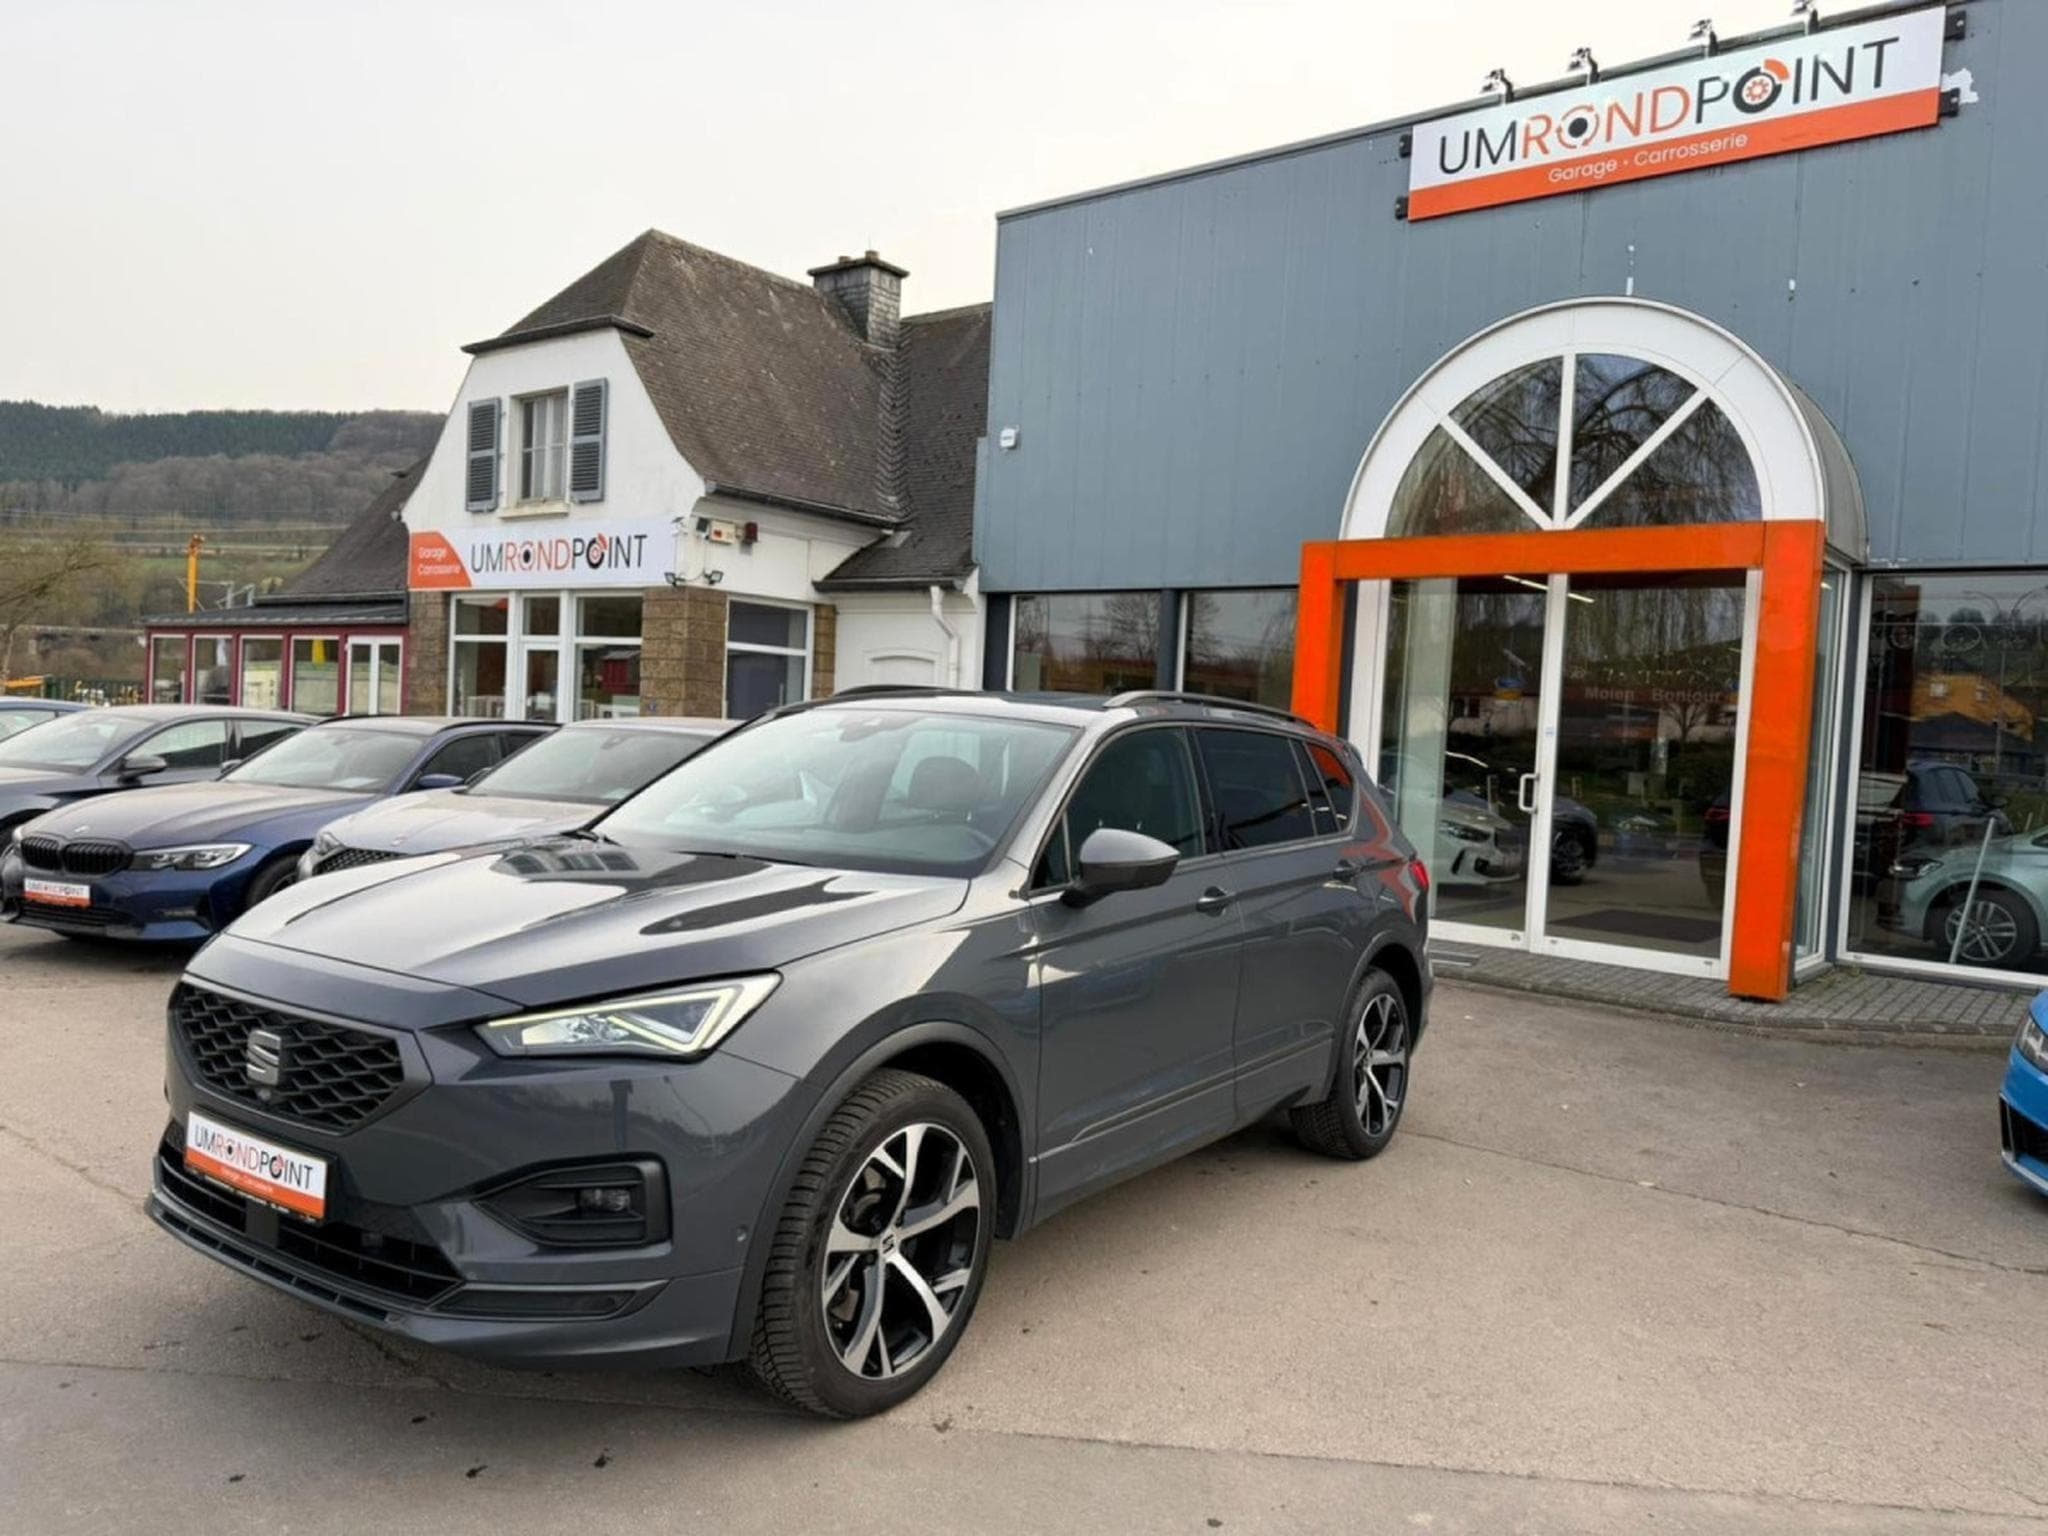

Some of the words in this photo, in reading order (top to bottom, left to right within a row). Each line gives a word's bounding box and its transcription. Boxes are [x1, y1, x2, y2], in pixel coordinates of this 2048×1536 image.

[1438, 36, 1900, 174] UMRONDPOINT
[1547, 157, 1618, 184] Garage
[1633, 132, 1749, 167] Carrosserie
[470, 532, 648, 574] UMRONDPOINT
